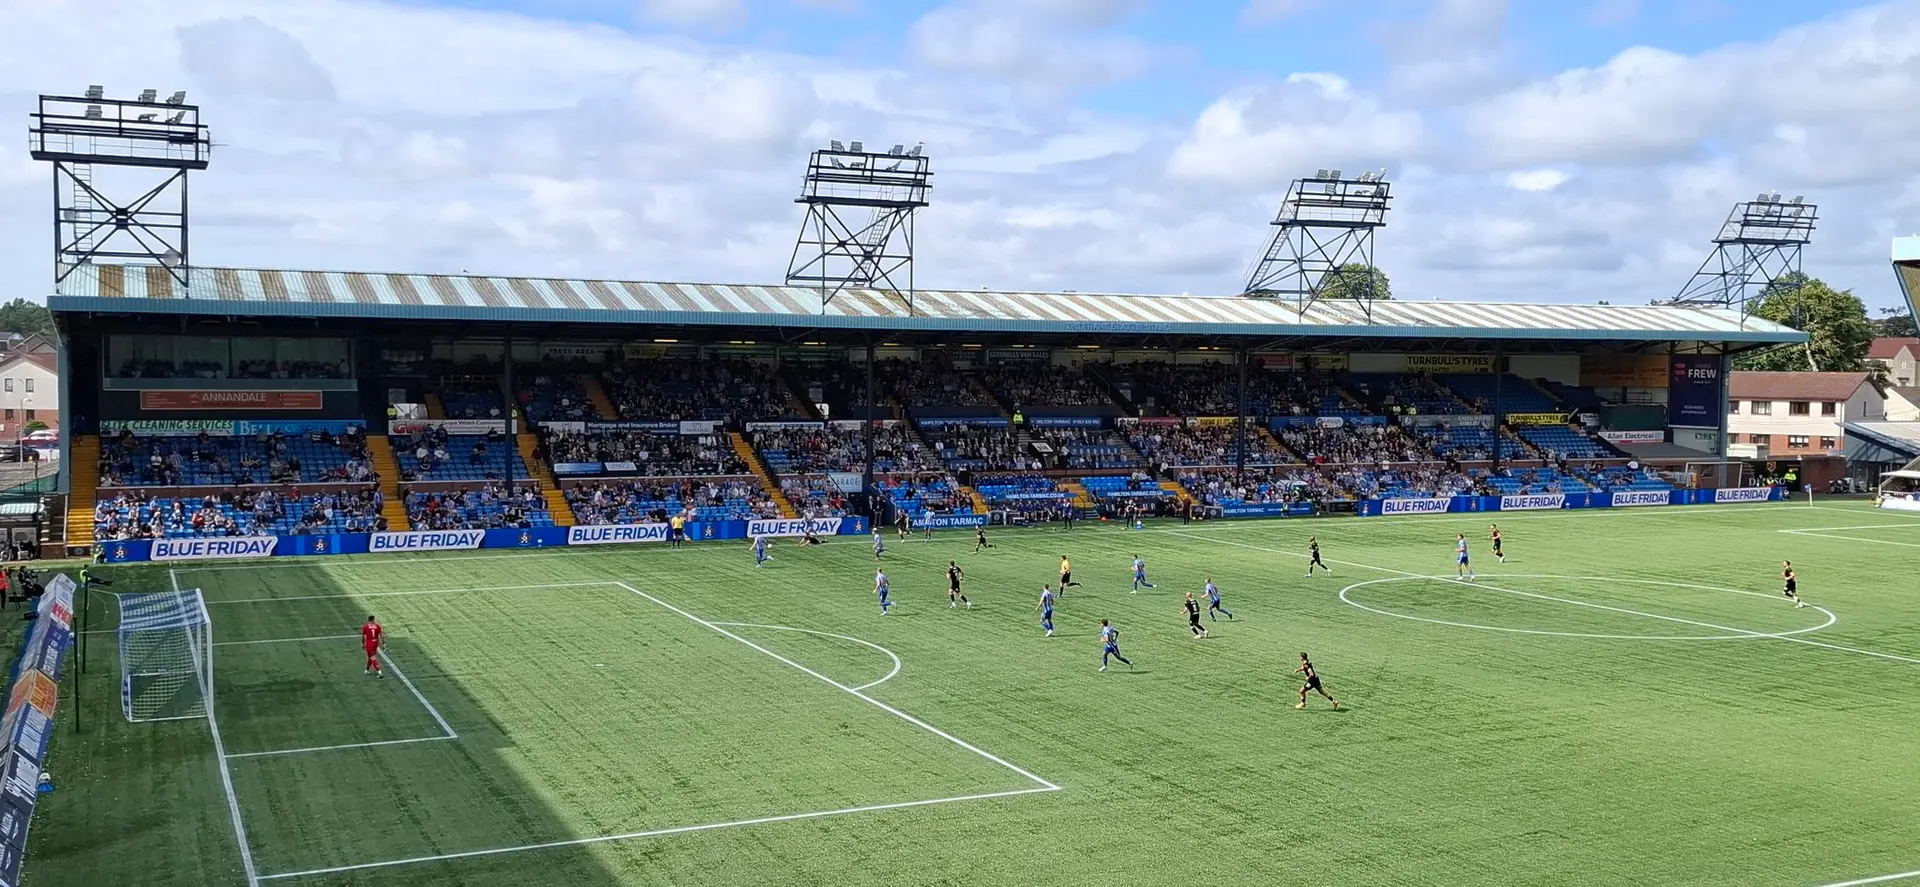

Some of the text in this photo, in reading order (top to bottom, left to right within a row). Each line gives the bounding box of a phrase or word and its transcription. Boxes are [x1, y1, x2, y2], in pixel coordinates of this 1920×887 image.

[1407, 356, 1489, 365] TURNBULL'S TYRES
[1688, 369, 1717, 379] FREW
[202, 392, 267, 402] ANNANDALE
[101, 420, 233, 430] ELITE CLEANING SERVICES
[587, 421, 617, 429] Mortgage
[1614, 492, 1670, 504] BLUE FRIDAY
[1717, 489, 1770, 500] BLUE FRIDAY
[1384, 499, 1448, 512] BLUE FRIDAY
[1503, 496, 1563, 508] BLUE FRIDAY
[949, 516, 984, 526] TARMAC
[750, 520, 838, 535] BLUE FRDAY
[572, 525, 668, 542] BLUE FRIDAY
[374, 532, 481, 549] BLUE FRIDAY
[156, 539, 273, 557] BLUE FRIDAY
[371, 628, 376, 638] 1
